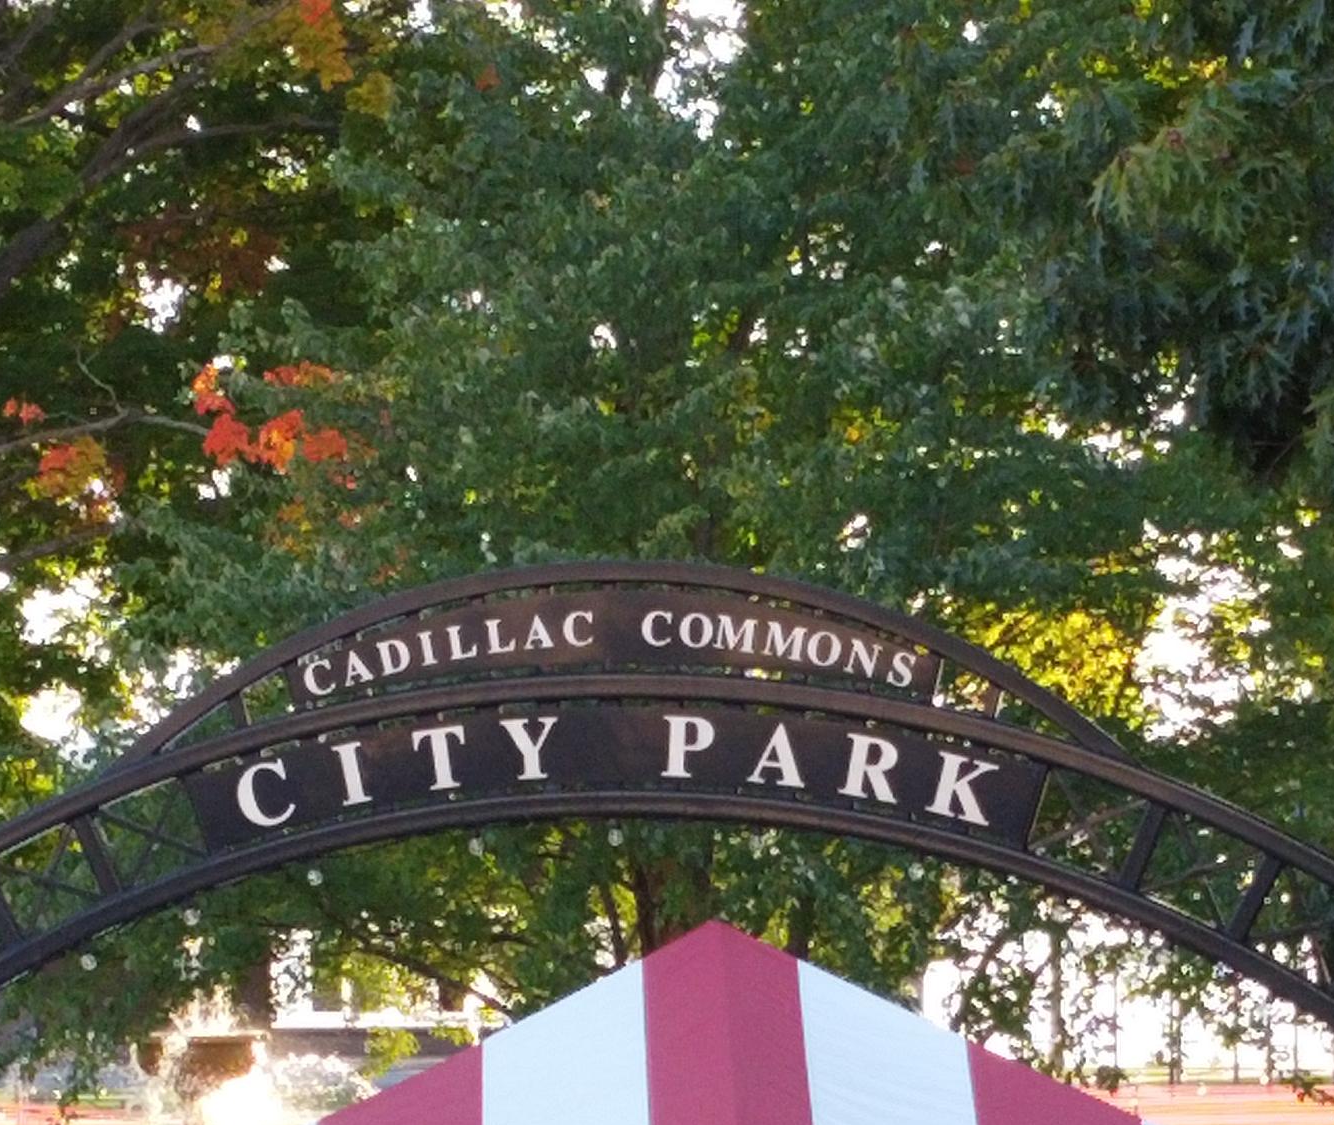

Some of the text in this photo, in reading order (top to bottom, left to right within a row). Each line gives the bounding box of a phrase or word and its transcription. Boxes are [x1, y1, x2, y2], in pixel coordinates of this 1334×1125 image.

[303, 609, 918, 697] CADILLAC COMMONS
[235, 714, 1001, 829] CITY PARK
